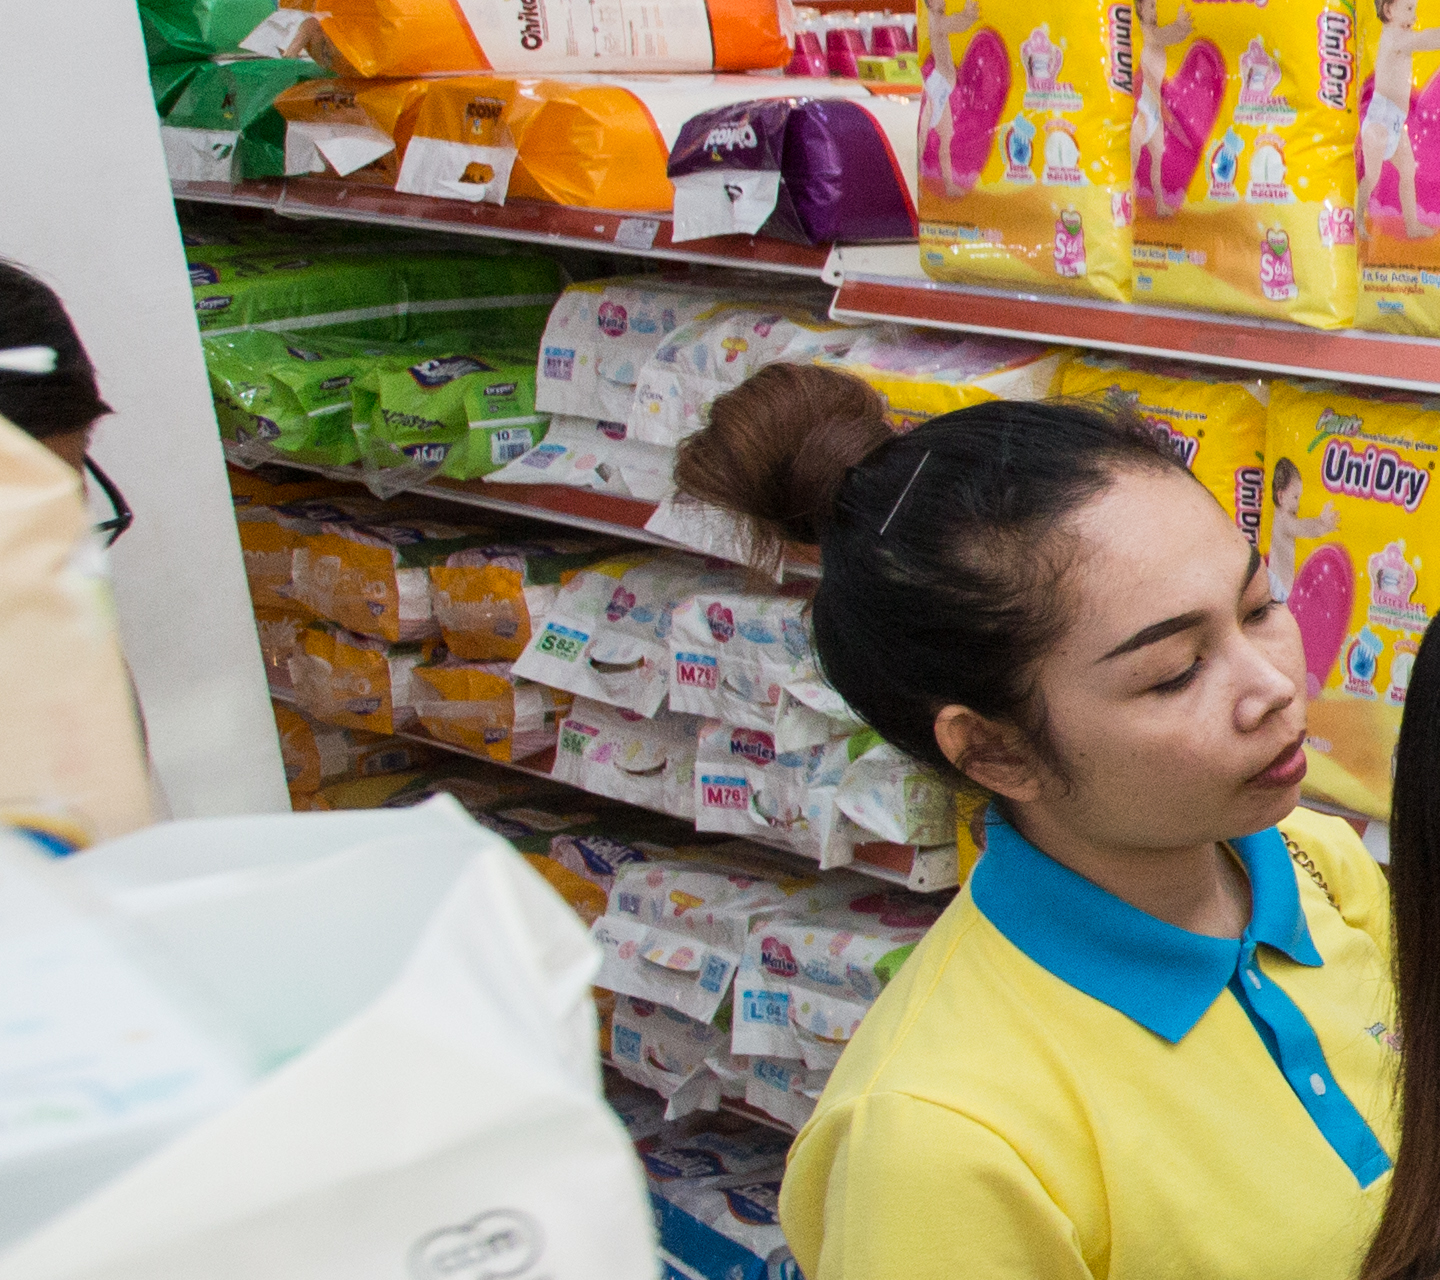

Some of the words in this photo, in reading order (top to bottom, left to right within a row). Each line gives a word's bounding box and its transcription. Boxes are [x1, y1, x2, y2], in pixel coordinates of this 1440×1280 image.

[1320, 10, 1354, 108] UniDry
[1260, 254, 1275, 281] S
[494, 428, 511, 442] 10
[1323, 446, 1429, 509] UniDry
[540, 633, 556, 652] S
[680, 664, 698, 683] M
[706, 787, 724, 804] M
